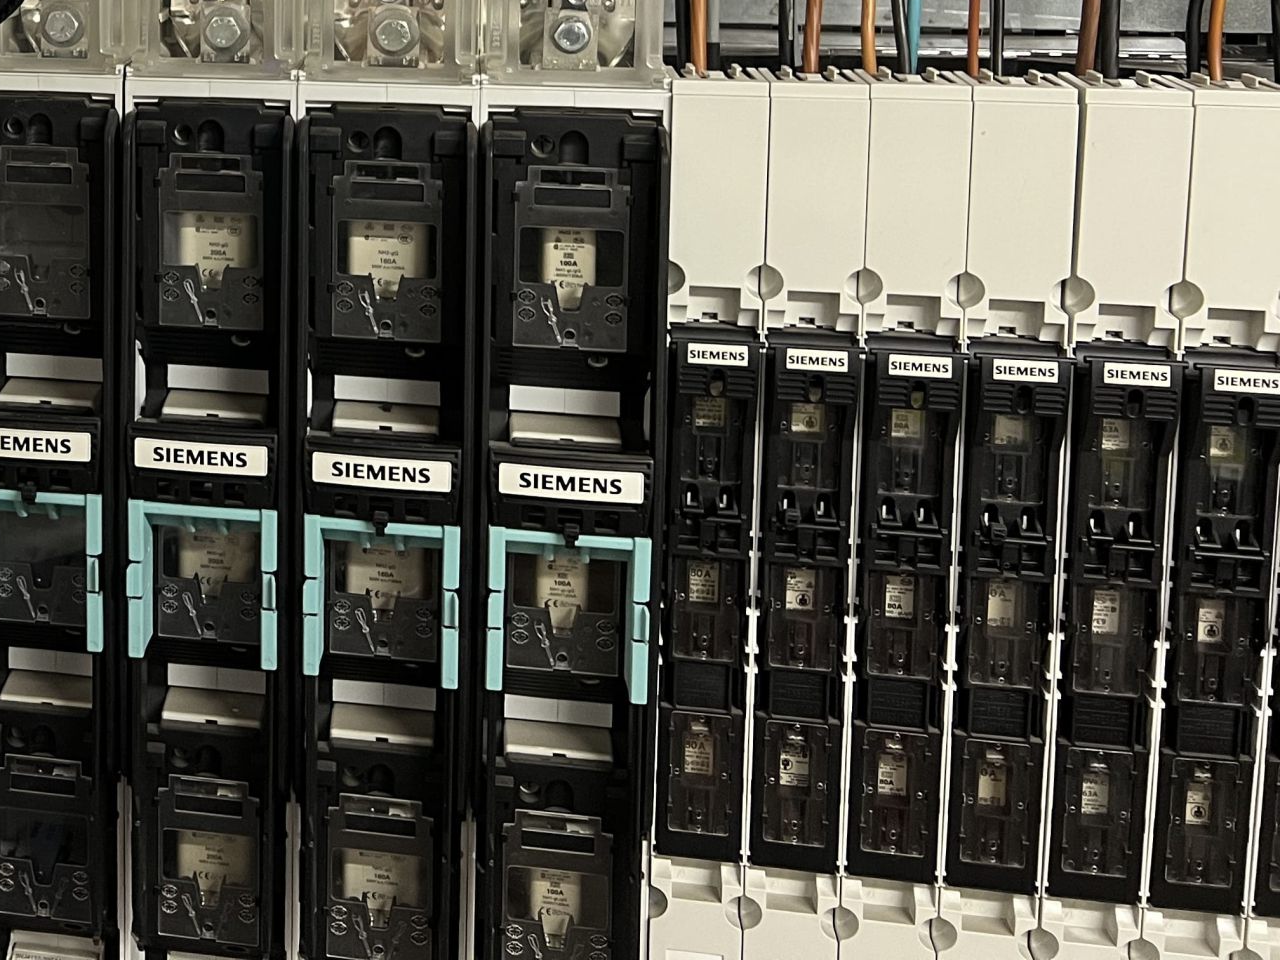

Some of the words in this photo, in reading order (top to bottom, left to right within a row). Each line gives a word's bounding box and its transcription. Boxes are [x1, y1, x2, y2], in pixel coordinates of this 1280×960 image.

[560, 260, 578, 268] 100A
[689, 349, 745, 361] SIEMENS
[788, 355, 846, 367] SIEMENS
[890, 360, 949, 373] SIEMENS
[995, 365, 1055, 378] SIEMENS
[1107, 369, 1168, 382] SIEMENS
[1217, 375, 1279, 389] SIEMENS
[152, 446, 249, 468] SIEMENS
[330, 461, 431, 484] SIEMENS
[519, 472, 622, 496] SIEMENS
